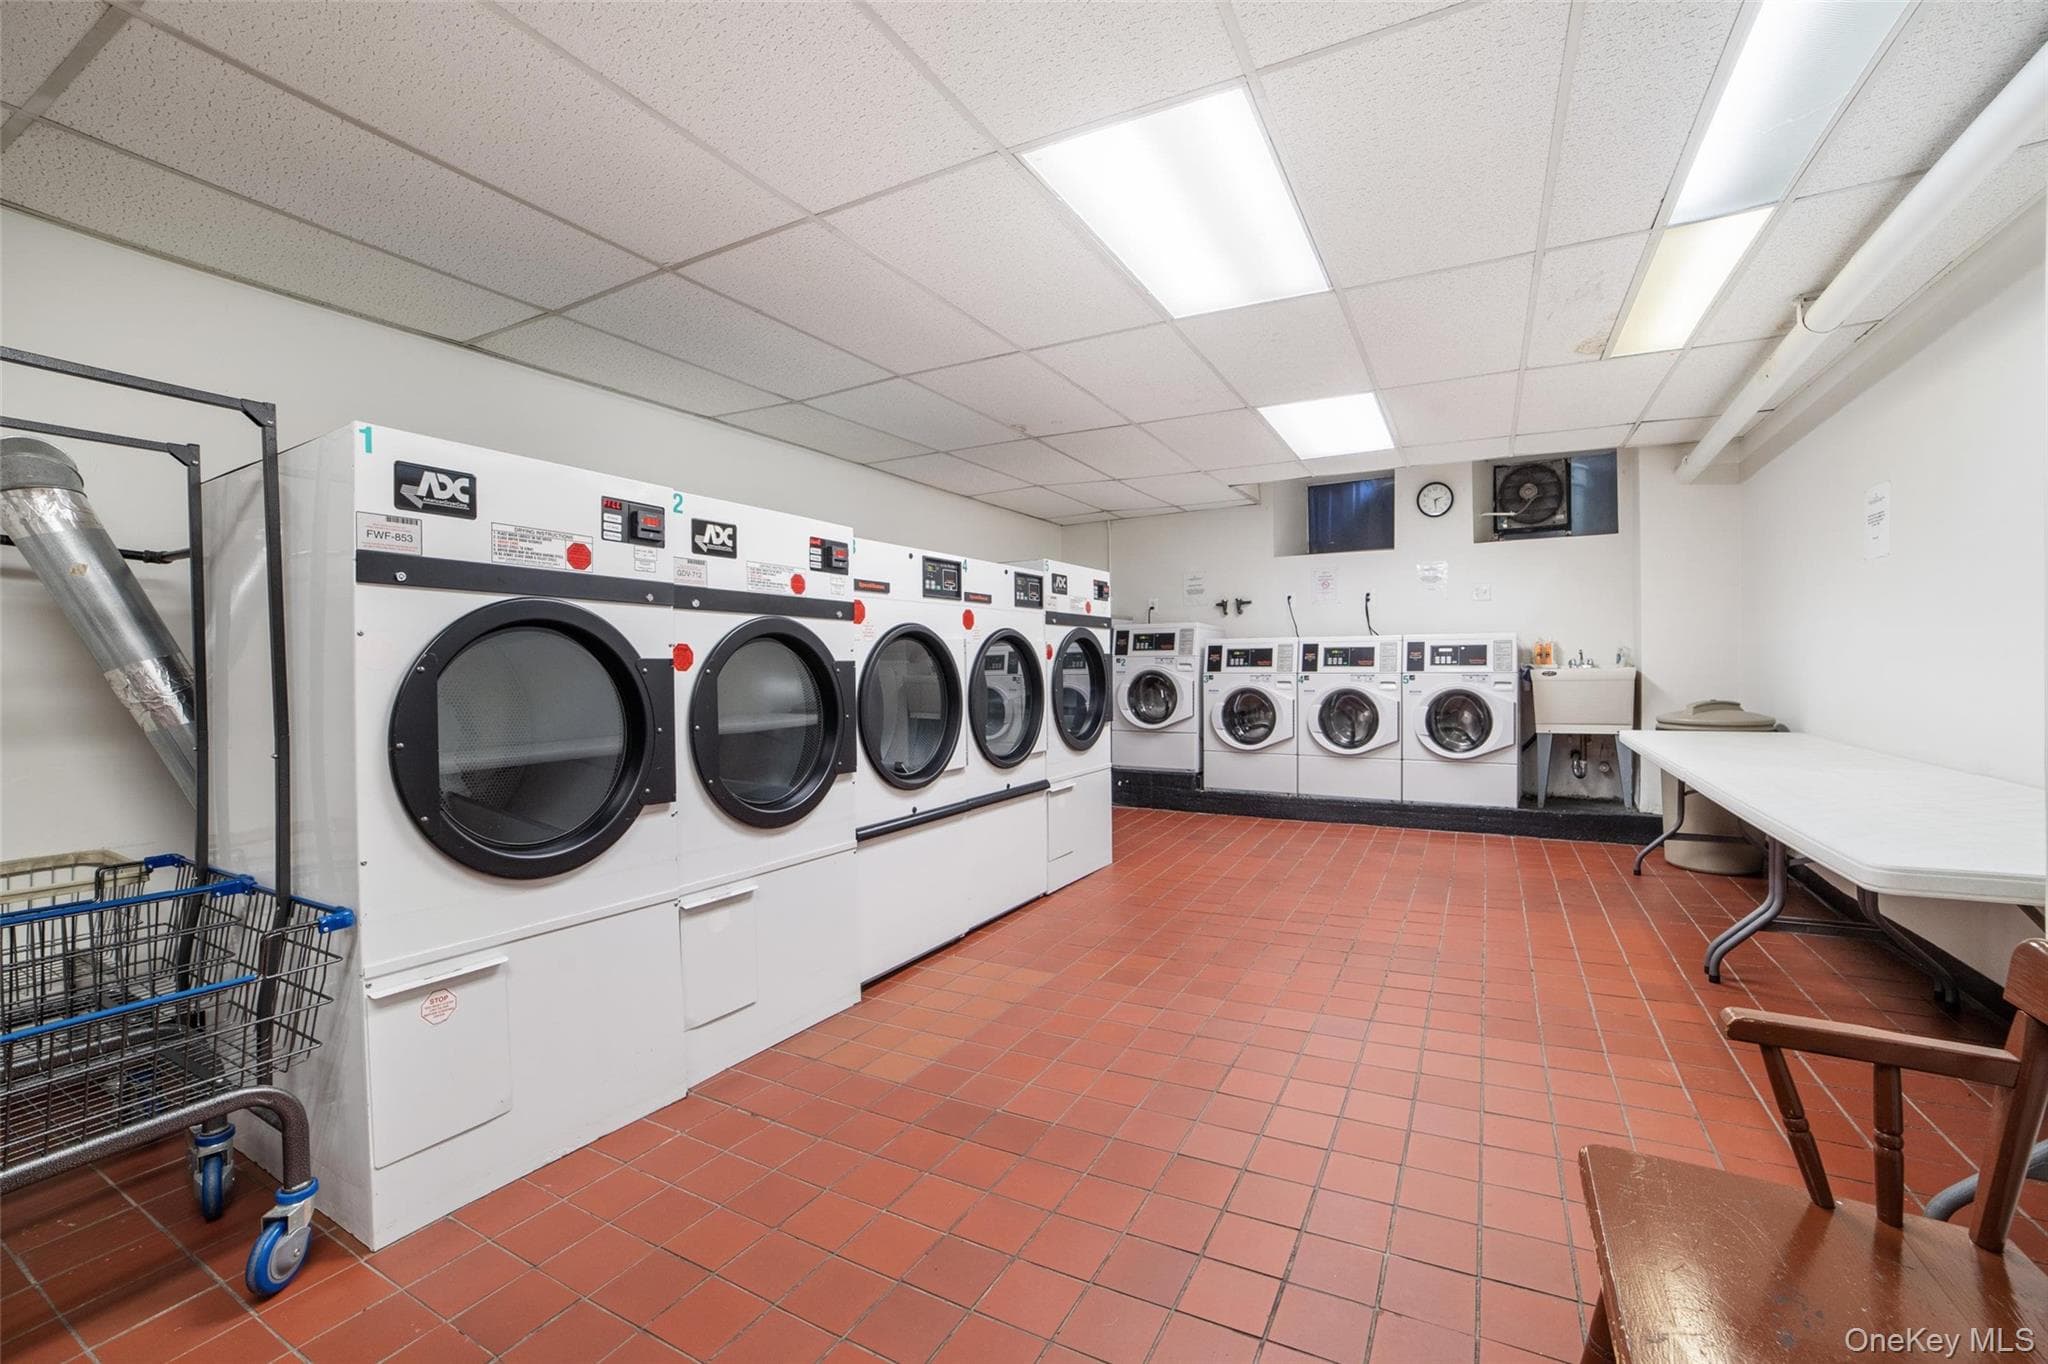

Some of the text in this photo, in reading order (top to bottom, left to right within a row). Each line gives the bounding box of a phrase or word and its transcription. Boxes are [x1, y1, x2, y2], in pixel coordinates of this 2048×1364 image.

[359, 426, 372, 453] 1
[417, 471, 470, 504] ADC
[672, 493, 683, 514] 2
[366, 529, 414, 543] FWF-853
[703, 524, 733, 547] ADC
[963, 559, 968, 573] 4
[1121, 658, 1126, 667] 2
[1403, 675, 1409, 684] 5
[430, 994, 449, 1005] STOP
